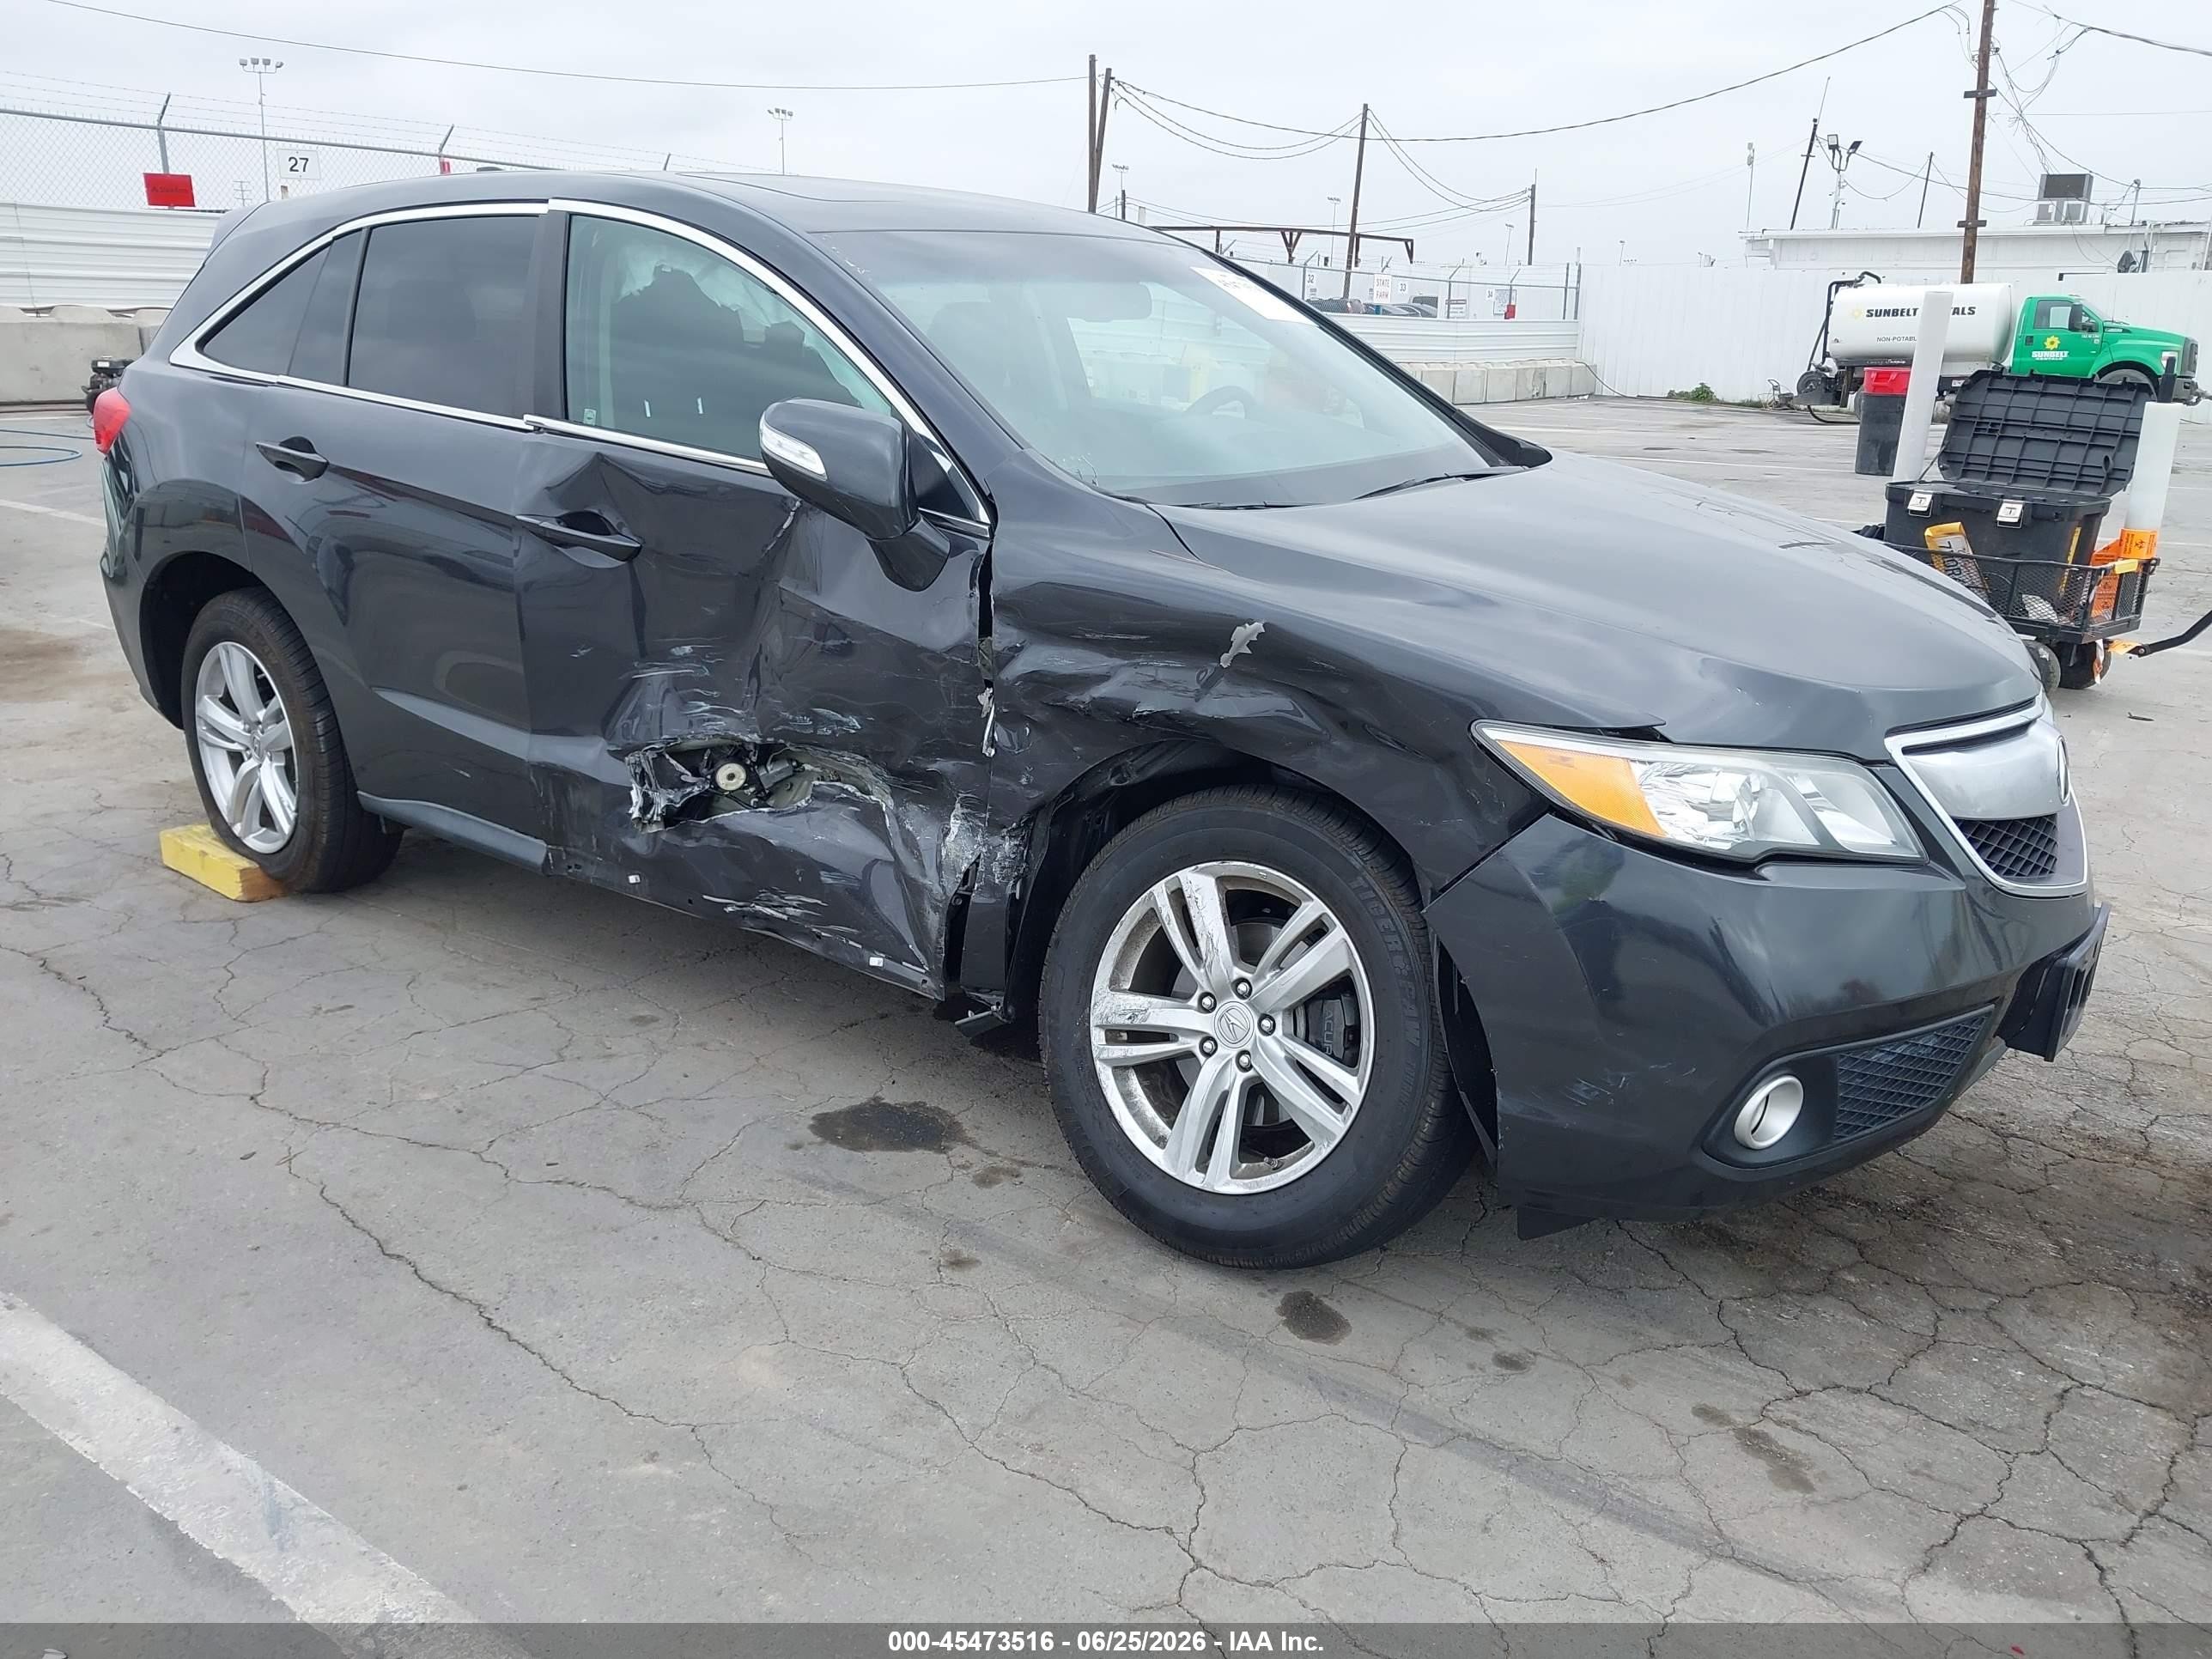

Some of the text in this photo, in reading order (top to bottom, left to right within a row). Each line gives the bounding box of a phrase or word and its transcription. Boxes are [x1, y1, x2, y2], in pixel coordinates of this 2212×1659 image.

[288, 156, 309, 173] 27
[1307, 275, 1315, 283] 32
[1376, 278, 1390, 288] STATE
[1400, 283, 1407, 292] 33
[1376, 290, 1389, 299] FARM
[1865, 307, 1919, 318] SUNBELT
[1348, 876, 1404, 951] TIGER
[1324, 1009, 1334, 1055] ACUR
